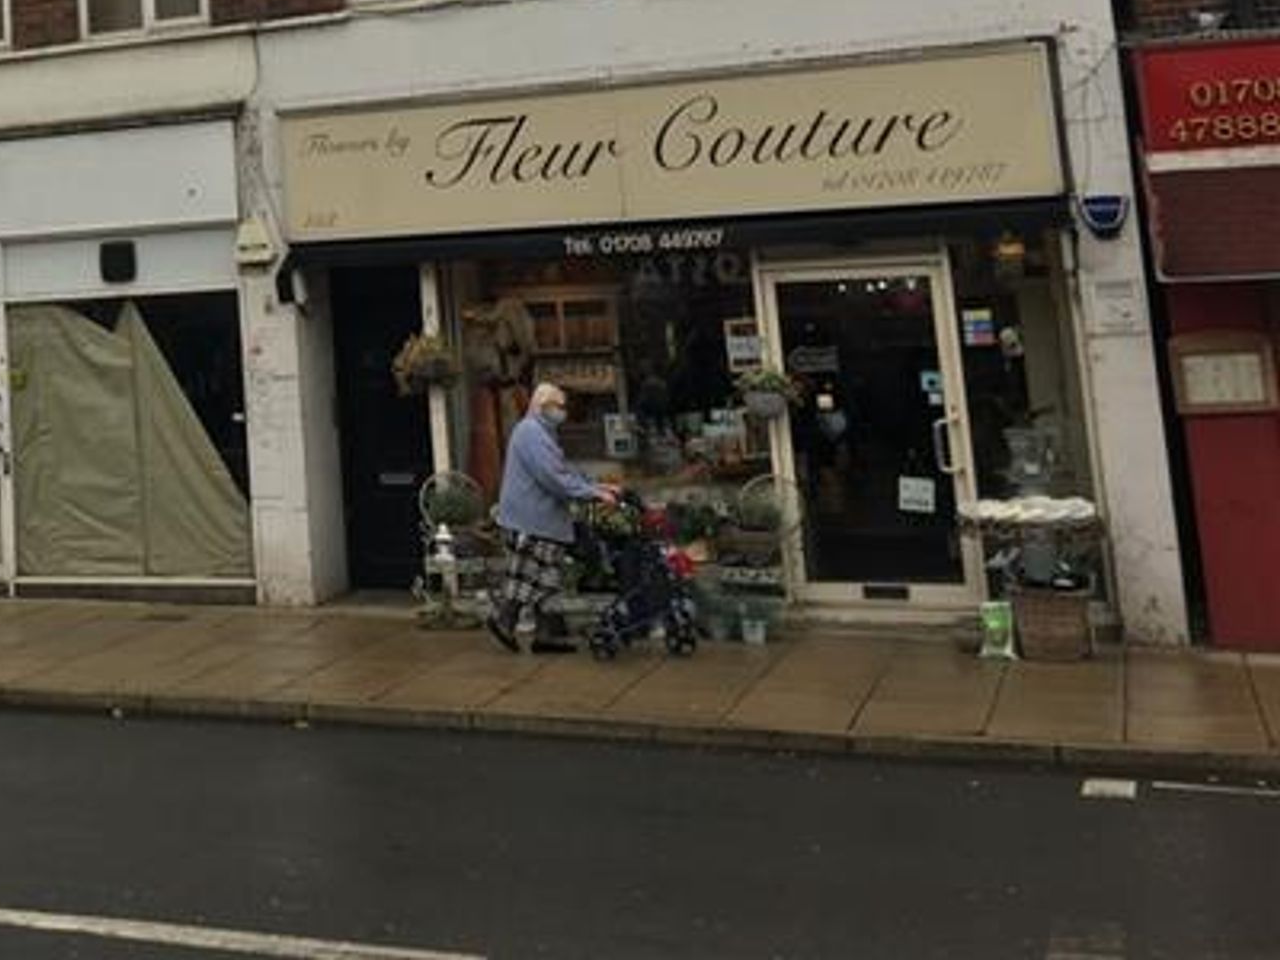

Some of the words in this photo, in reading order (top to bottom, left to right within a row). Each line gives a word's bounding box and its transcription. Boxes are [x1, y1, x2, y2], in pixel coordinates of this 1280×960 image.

[1190, 76, 1280, 108] 0170
[425, 114, 619, 189] Fleur
[654, 95, 963, 171] Couture
